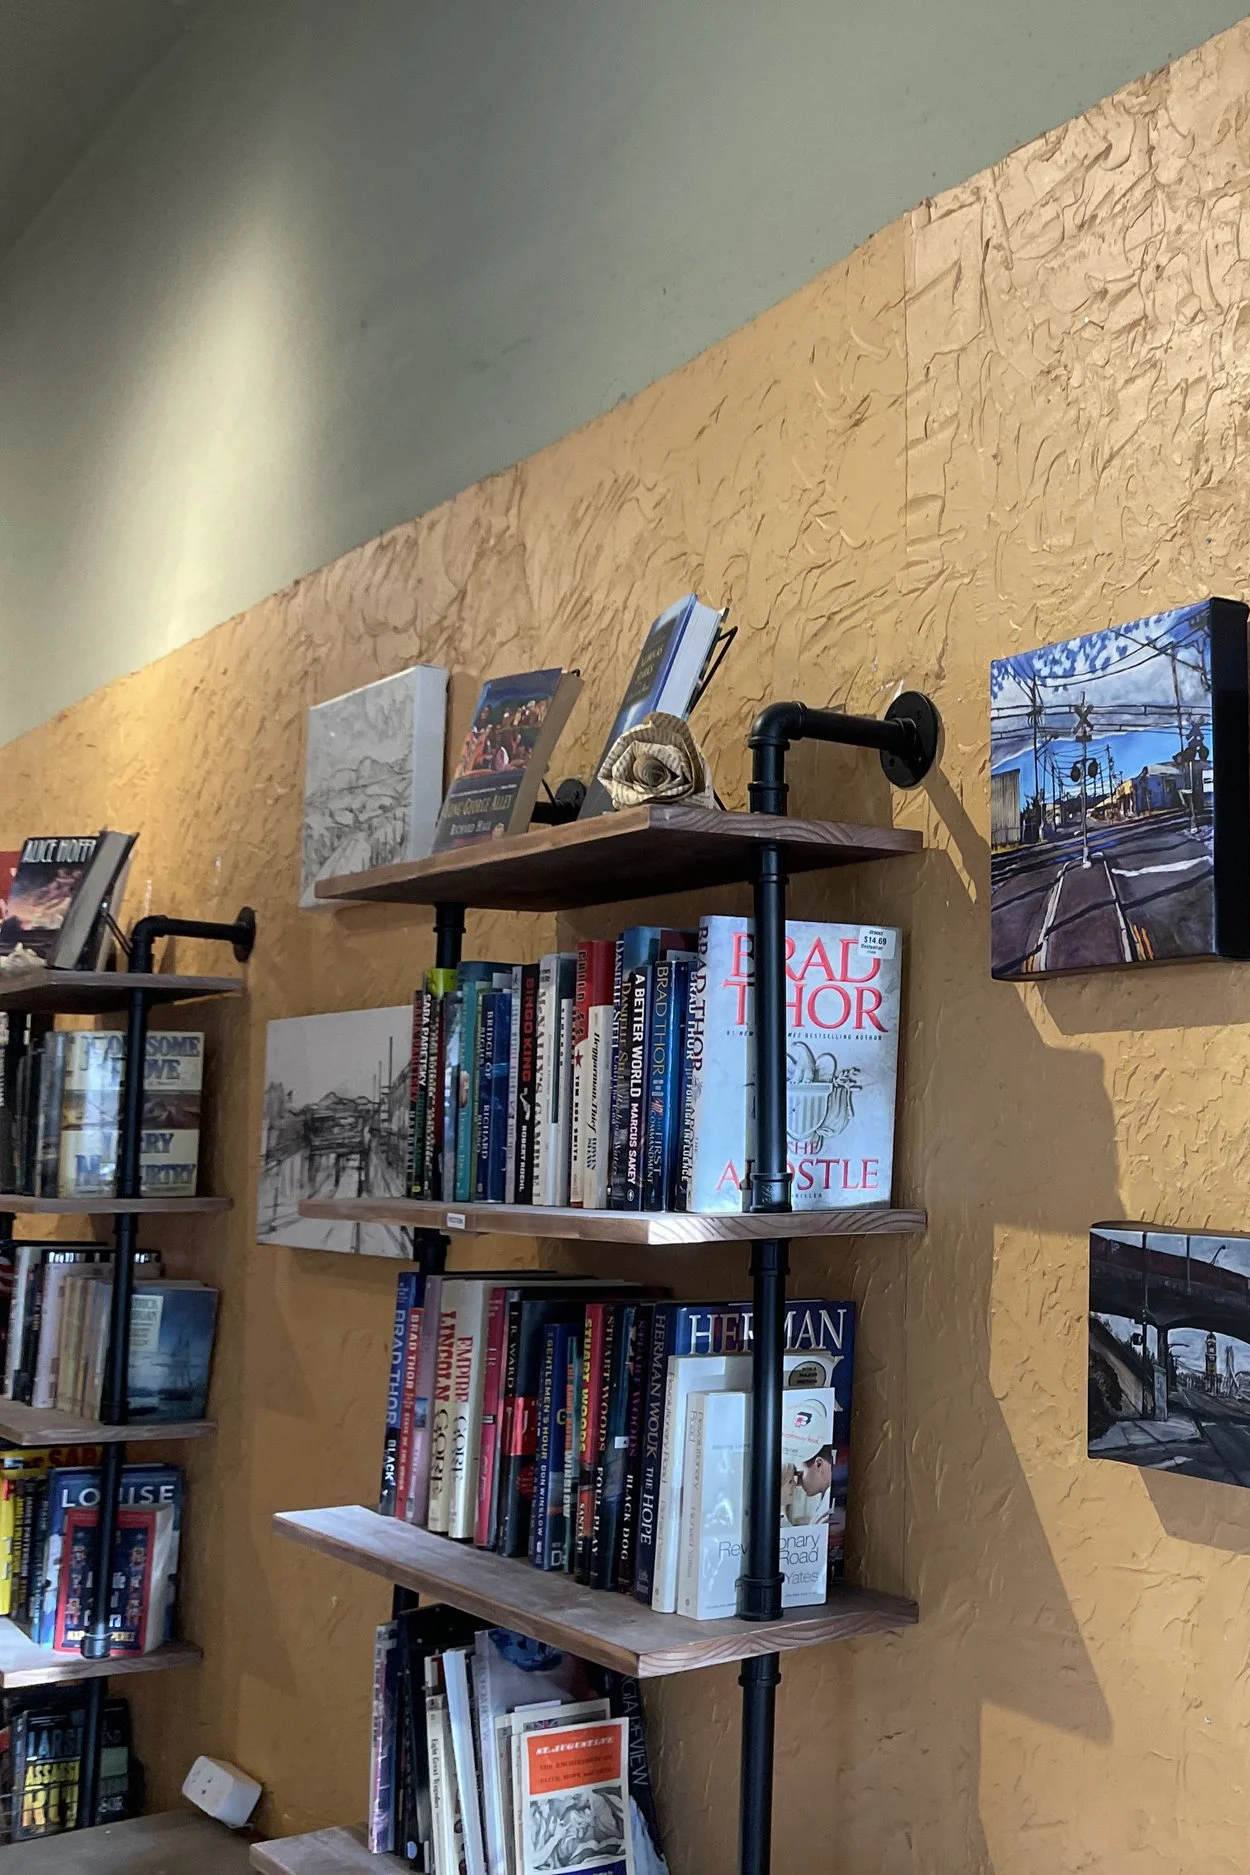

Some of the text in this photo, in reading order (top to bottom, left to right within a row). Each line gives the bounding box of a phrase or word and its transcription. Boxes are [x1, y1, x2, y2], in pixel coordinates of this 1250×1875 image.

[449, 819, 492, 836] RICHARD HALL
[492, 794, 514, 811] ALLEY
[21, 838, 57, 863] ALICE
[729, 931, 882, 983] BRAD
[863, 935, 887, 946] $14.69
[610, 939, 626, 1053] DANIELLE STEEL
[619, 981, 632, 1047] DANIELLE
[687, 970, 699, 1016] BRAD
[690, 925, 709, 1073] BRAD THOR
[722, 977, 889, 1034] THOR
[418, 993, 432, 1087] SARA PARETSKY
[484, 1010, 494, 1080] BRIDGE OF
[521, 977, 536, 1082] BINGO KING
[652, 965, 669, 1076] BRAD THOR
[685, 1019, 696, 1060] THOR
[855, 1033, 883, 1041] AUTHOR
[80, 1034, 200, 1071] LOSOME
[626, 973, 646, 1185] A BETTER WORLD MARCUS SAKEY
[684, 1083, 694, 1124] FOREIGN
[481, 1103, 491, 1160] RICHARD
[519, 1125, 528, 1160] ROBERT
[651, 1132, 663, 1177] FIRST
[680, 1123, 692, 1182] INFLUENCE
[786, 1140, 819, 1155] HE
[385, 1309, 407, 1426] BRAD THOR
[405, 1313, 420, 1390] BRAD THOR
[435, 1310, 457, 1402] LINCOLN
[454, 1335, 474, 1405] EMPIRE
[506, 1341, 517, 1389] WARD
[581, 1318, 593, 1383] STUART
[540, 1425, 550, 1460] HOUR
[578, 1387, 590, 1454] WOODS
[591, 1315, 616, 1554] STUART WOODS FOUL PLAY
[620, 1319, 647, 1561] STUART WOODS BLACK DOG
[639, 1313, 667, 1546] HERMAN WOUK THE HOPE
[689, 1410, 698, 1444] Road
[383, 1438, 397, 1482] BLACK
[539, 1464, 548, 1483] DON
[562, 1450, 573, 1518] WINSLOW
[536, 1483, 547, 1537] WINSLOW
[575, 1501, 585, 1535] SANTA
[778, 1549, 819, 1566] Road
[784, 1571, 819, 1585] Yates
